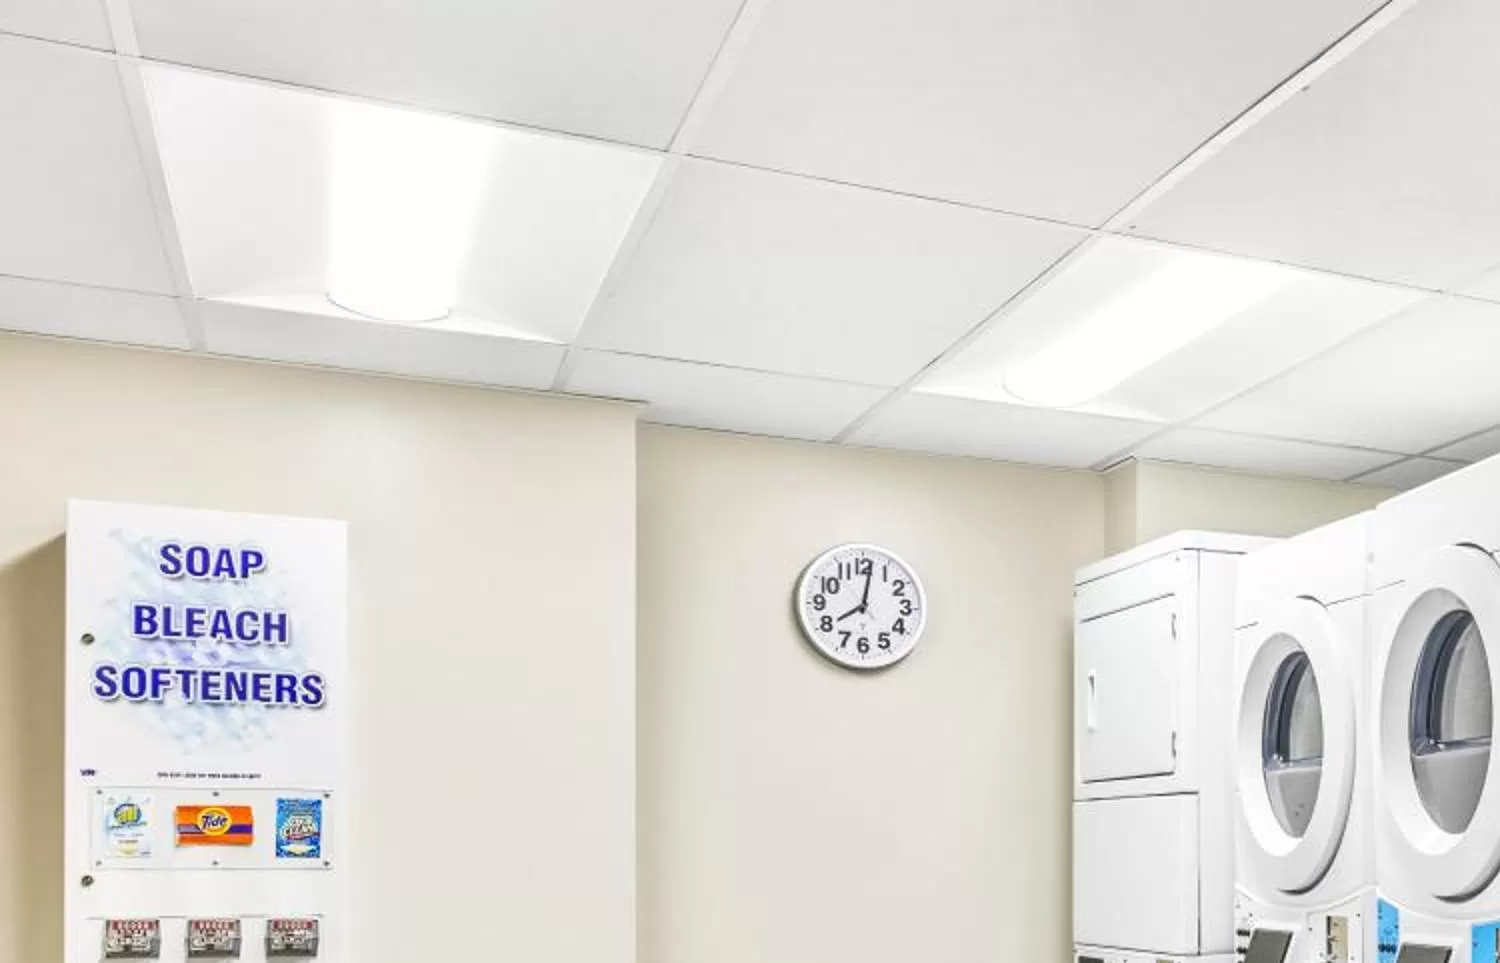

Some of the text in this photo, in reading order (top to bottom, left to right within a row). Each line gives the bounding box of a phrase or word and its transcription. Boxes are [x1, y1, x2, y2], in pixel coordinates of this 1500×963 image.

[160, 543, 263, 578] SOAP
[855, 558, 873, 575] 12
[838, 562, 851, 580] 11
[821, 576, 840, 594] 10
[892, 580, 905, 596] 2
[812, 594, 826, 611] 9
[899, 599, 912, 616] 3
[133, 605, 287, 642] BLEACH
[820, 615, 833, 632] 8
[891, 618, 905, 634] 4
[838, 631, 852, 648] 7
[857, 637, 870, 653] 6
[878, 632, 891, 649] 5
[94, 666, 323, 704] SOFTENERS
[201, 814, 228, 829] Tide
